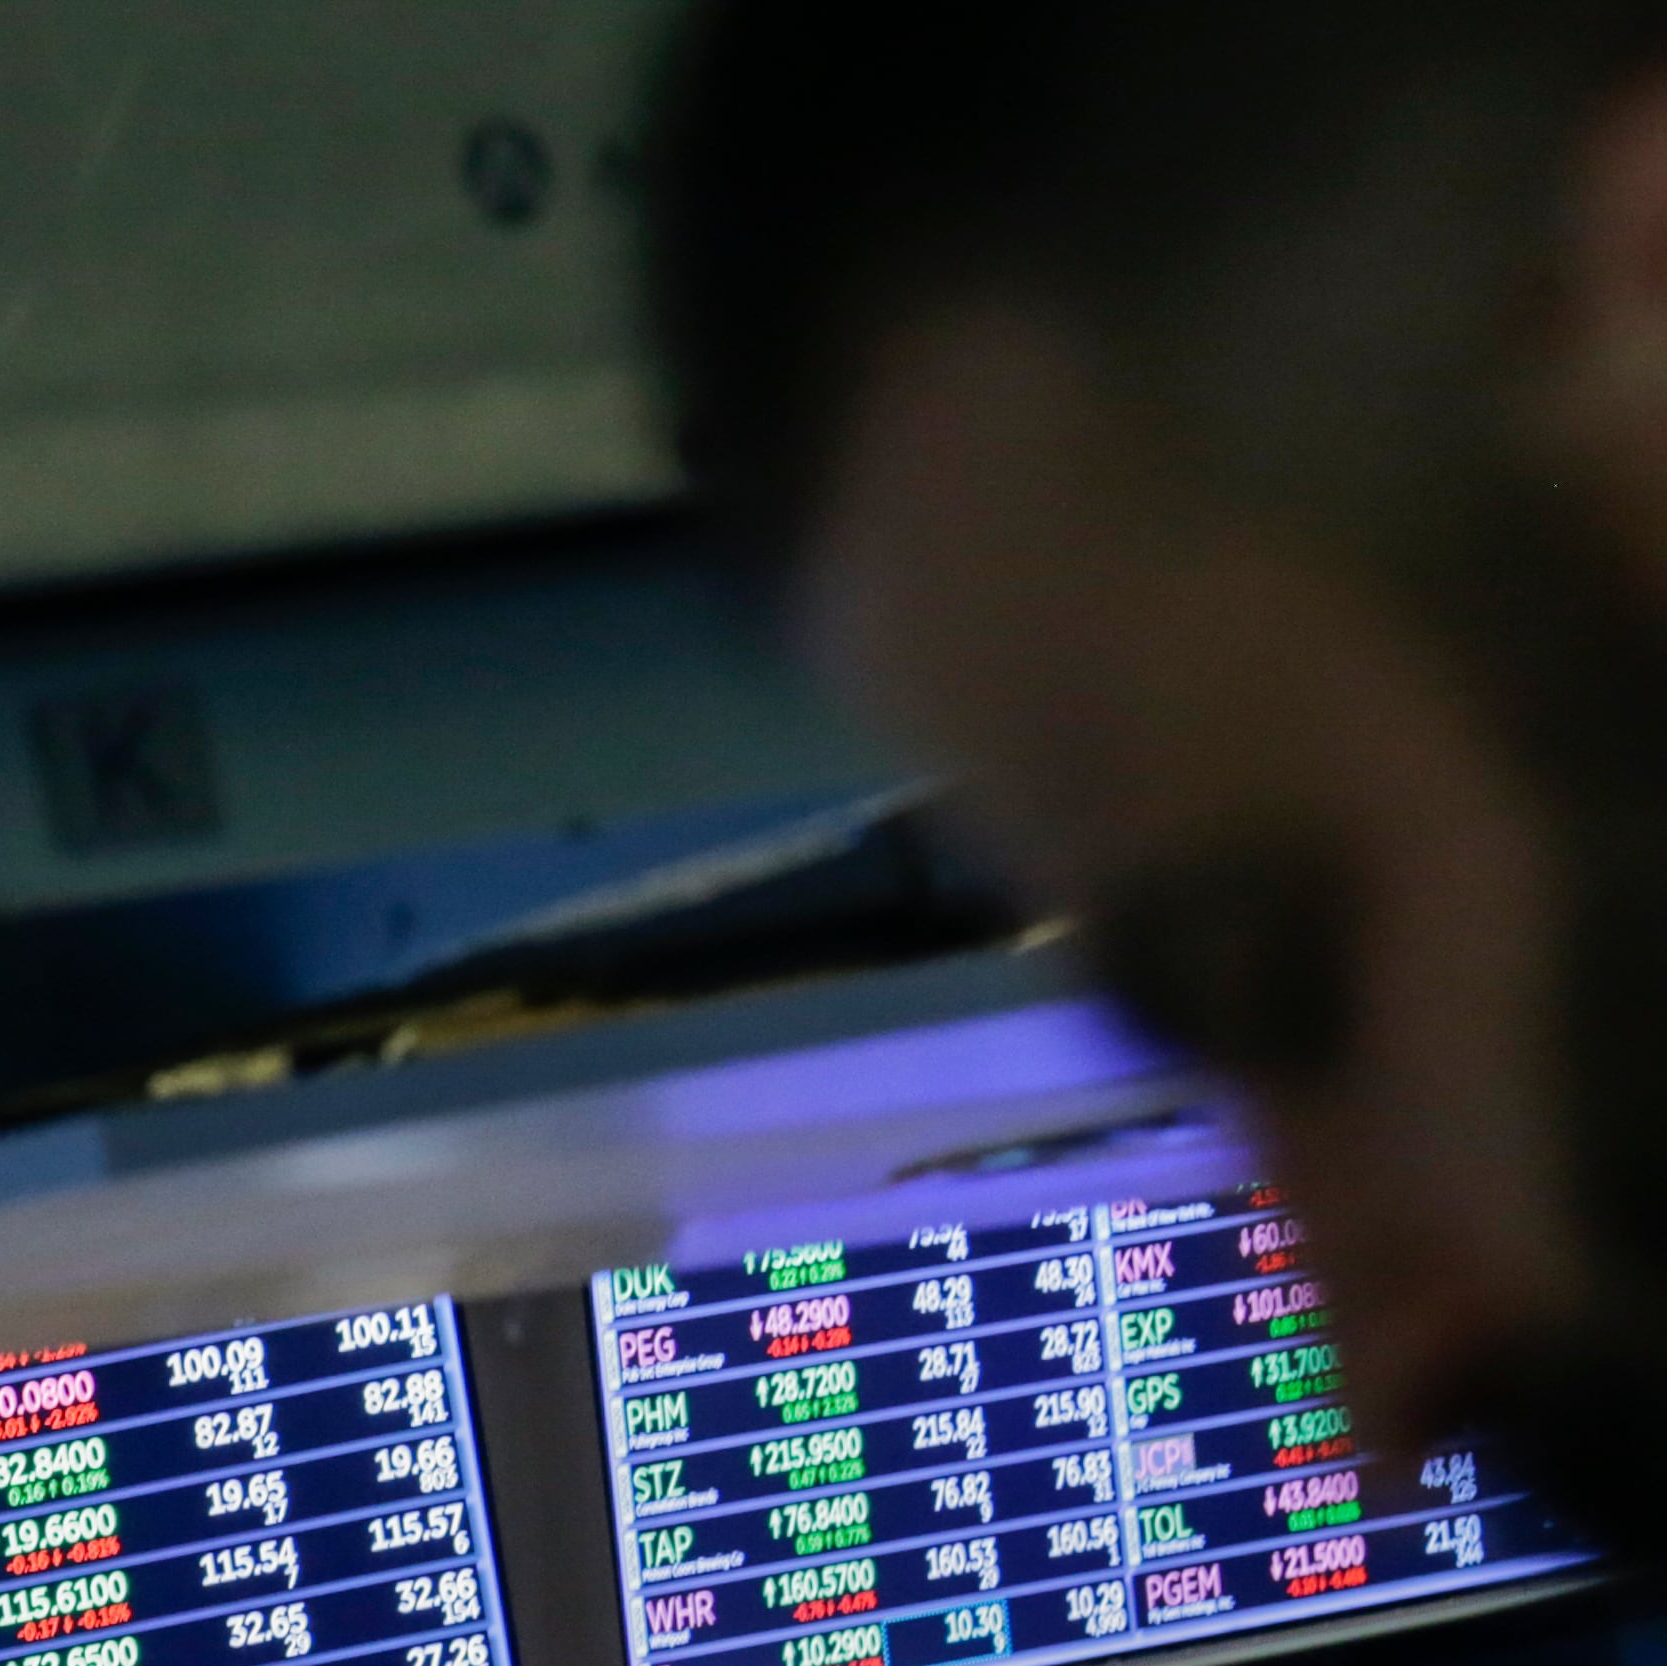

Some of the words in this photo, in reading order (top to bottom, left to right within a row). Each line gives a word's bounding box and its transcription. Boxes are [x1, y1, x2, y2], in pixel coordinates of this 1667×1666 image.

[613, 1263, 675, 1302] DUK
[1114, 1241, 1175, 1283] KMX
[335, 1304, 434, 1353] 100.11
[409, 1333, 436, 1359] 15
[619, 1327, 676, 1368] PEG
[1040, 1320, 1101, 1361] 28.72
[1121, 1307, 1173, 1350] EXP
[166, 1337, 264, 1387] 100.09
[229, 1365, 269, 1395] 111
[363, 1369, 445, 1416] 82.88
[408, 1399, 449, 1428] 141
[626, 1391, 688, 1435] PHM
[1128, 1373, 1182, 1414] GPS
[194, 1403, 273, 1449] 82.87
[252, 1431, 280, 1460] 12
[374, 1435, 456, 1483] 19.66
[1052, 1449, 1112, 1490] 76.83
[205, 1470, 287, 1517] 19.65
[633, 1459, 685, 1503] STZ
[1278, 1471, 1359, 1513] 43.8400
[2, 1503, 117, 1557] 19.6600
[263, 1497, 288, 1526] 17
[368, 1502, 464, 1553] 115.57
[1139, 1503, 1193, 1542] TOL
[199, 1536, 298, 1587] 115.54
[453, 1530, 470, 1556] 6
[639, 1526, 693, 1568] TAP
[394, 1567, 478, 1614] 32.66
[778, 1558, 875, 1607] 160.5700
[1145, 1563, 1222, 1610] PGEM
[226, 1602, 308, 1648] 32.65
[646, 1590, 716, 1635] WHR
[944, 1603, 1004, 1644] 10.30
[284, 1630, 312, 1658] 29
